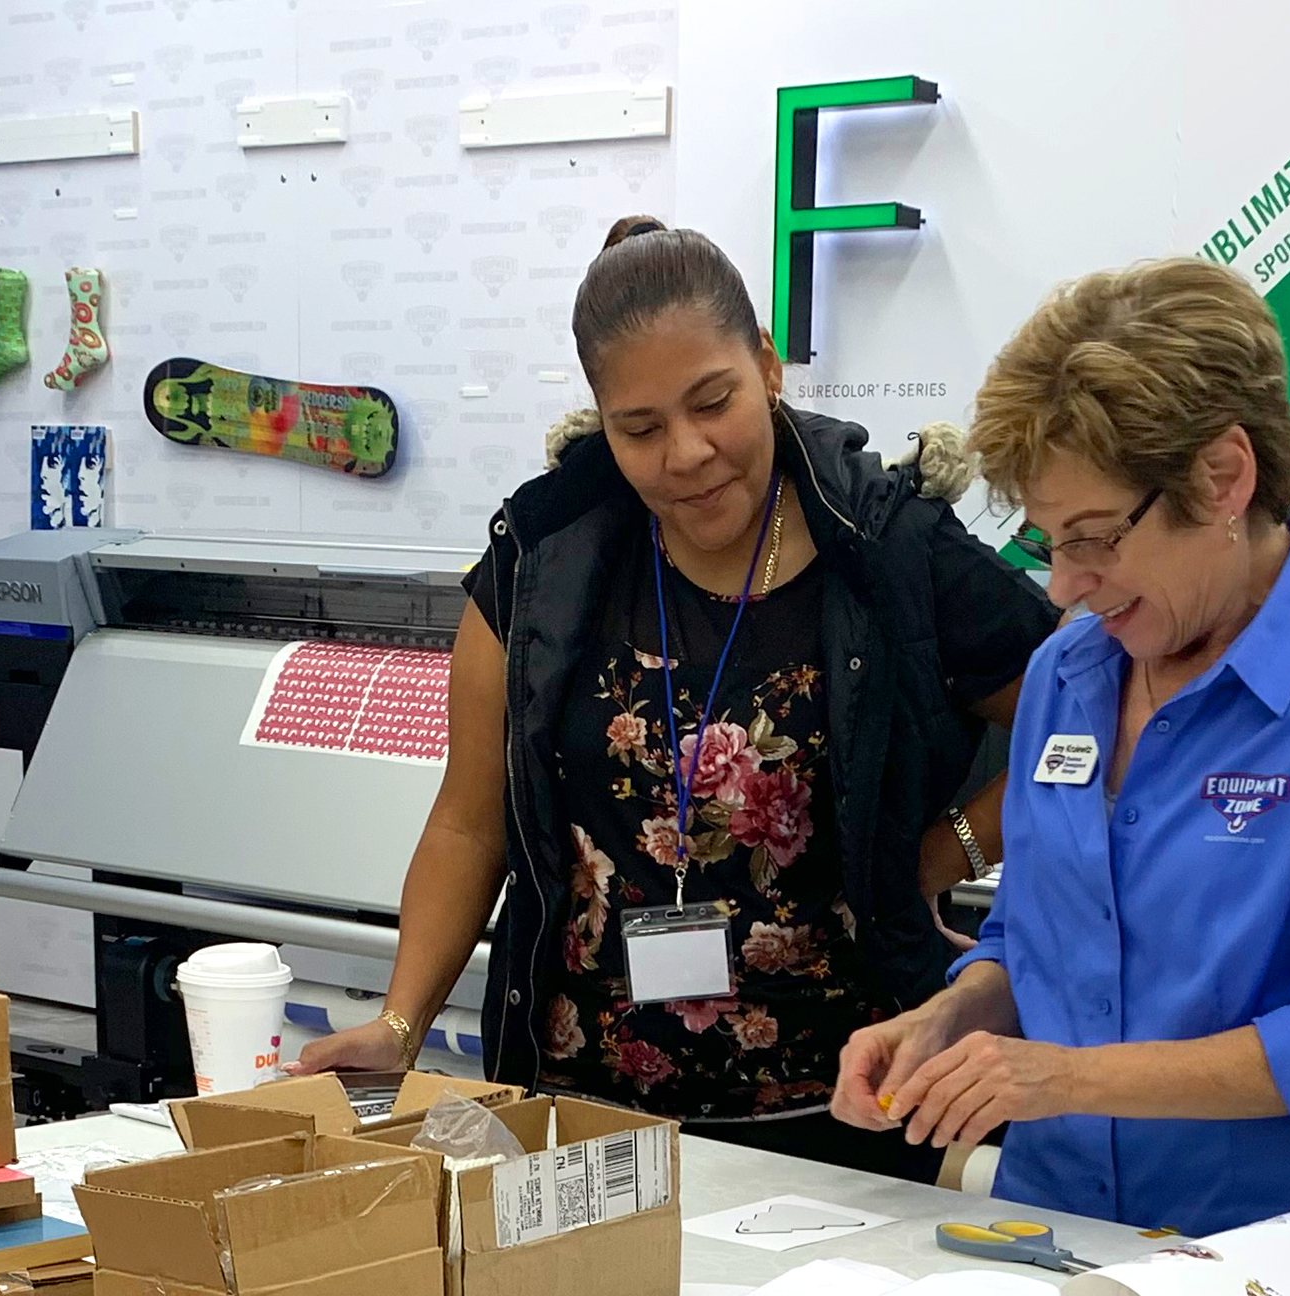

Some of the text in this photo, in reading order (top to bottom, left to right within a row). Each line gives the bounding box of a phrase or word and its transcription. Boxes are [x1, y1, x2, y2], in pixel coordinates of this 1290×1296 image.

[771, 75, 939, 363] F
[883, 382, 947, 398] F-SERIES
[1206, 776, 1288, 797] EQUIPMNT
[1223, 797, 1263, 814] ZONE
[556, 1156, 566, 1170] NJ
[534, 1197, 543, 1227] FRANKLIN
